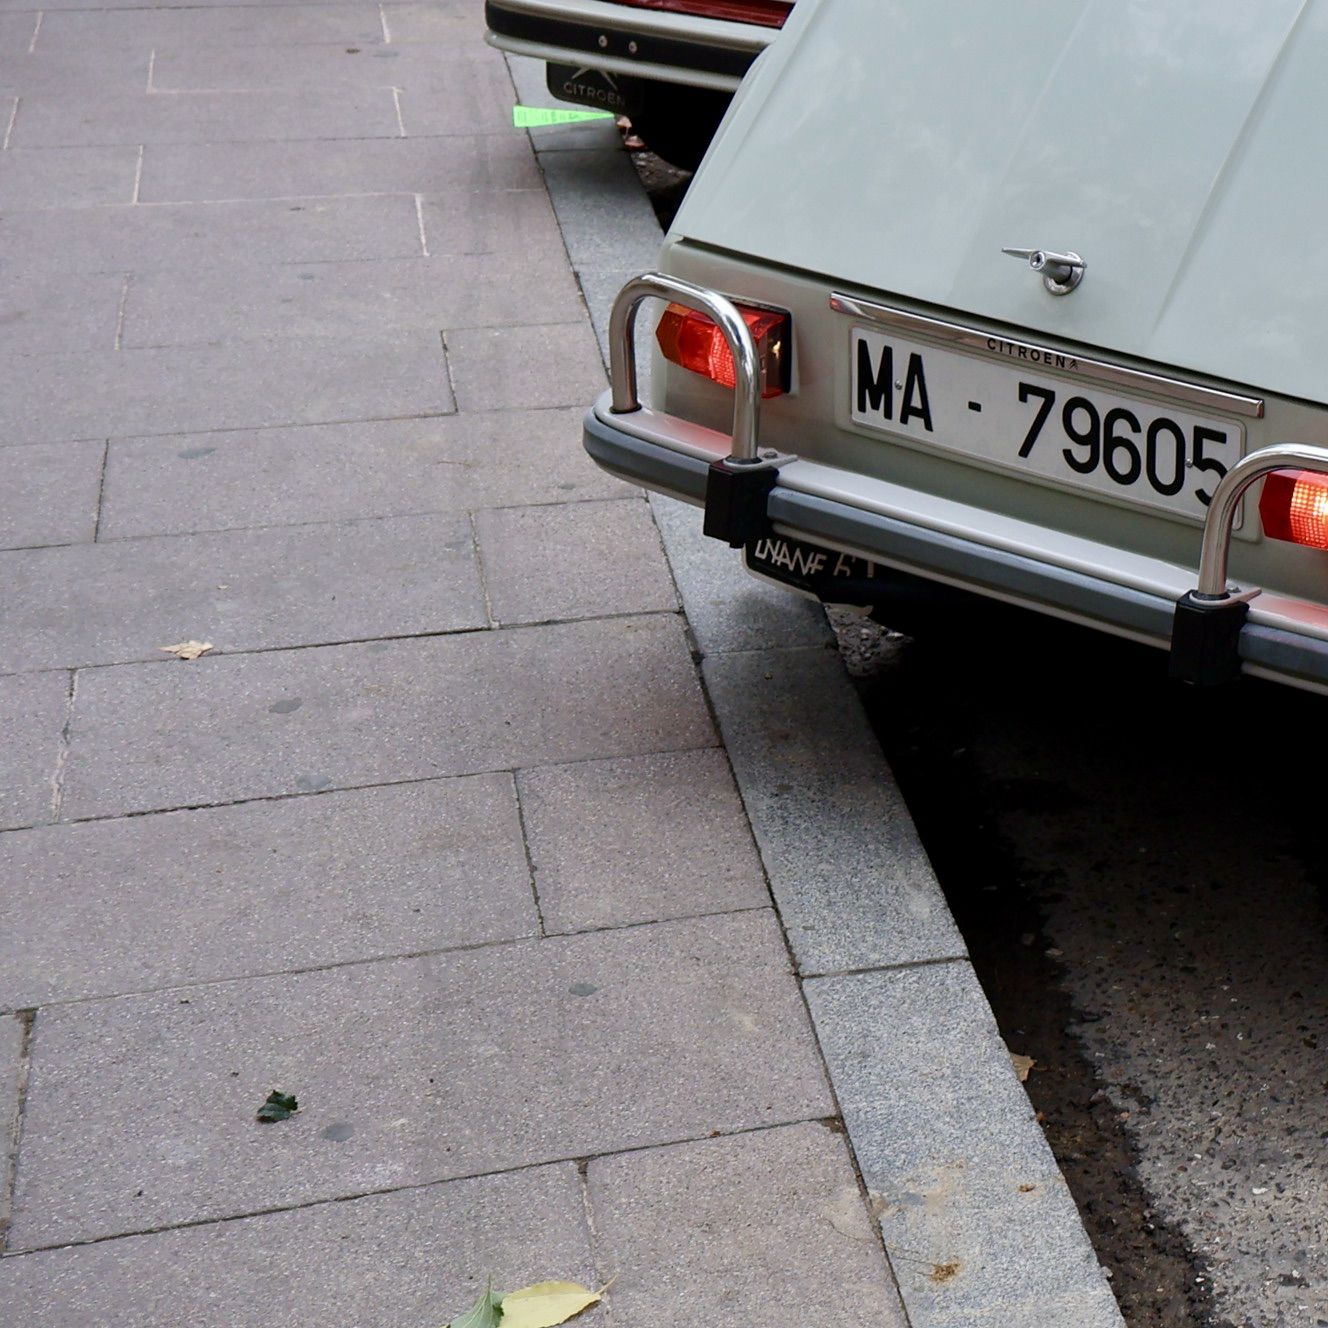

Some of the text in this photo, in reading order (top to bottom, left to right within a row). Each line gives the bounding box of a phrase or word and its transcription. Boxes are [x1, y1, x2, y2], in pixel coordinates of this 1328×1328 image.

[986, 338, 1067, 370] CITROEN
[856, 338, 934, 433] MA
[1018, 381, 1229, 508] 79605
